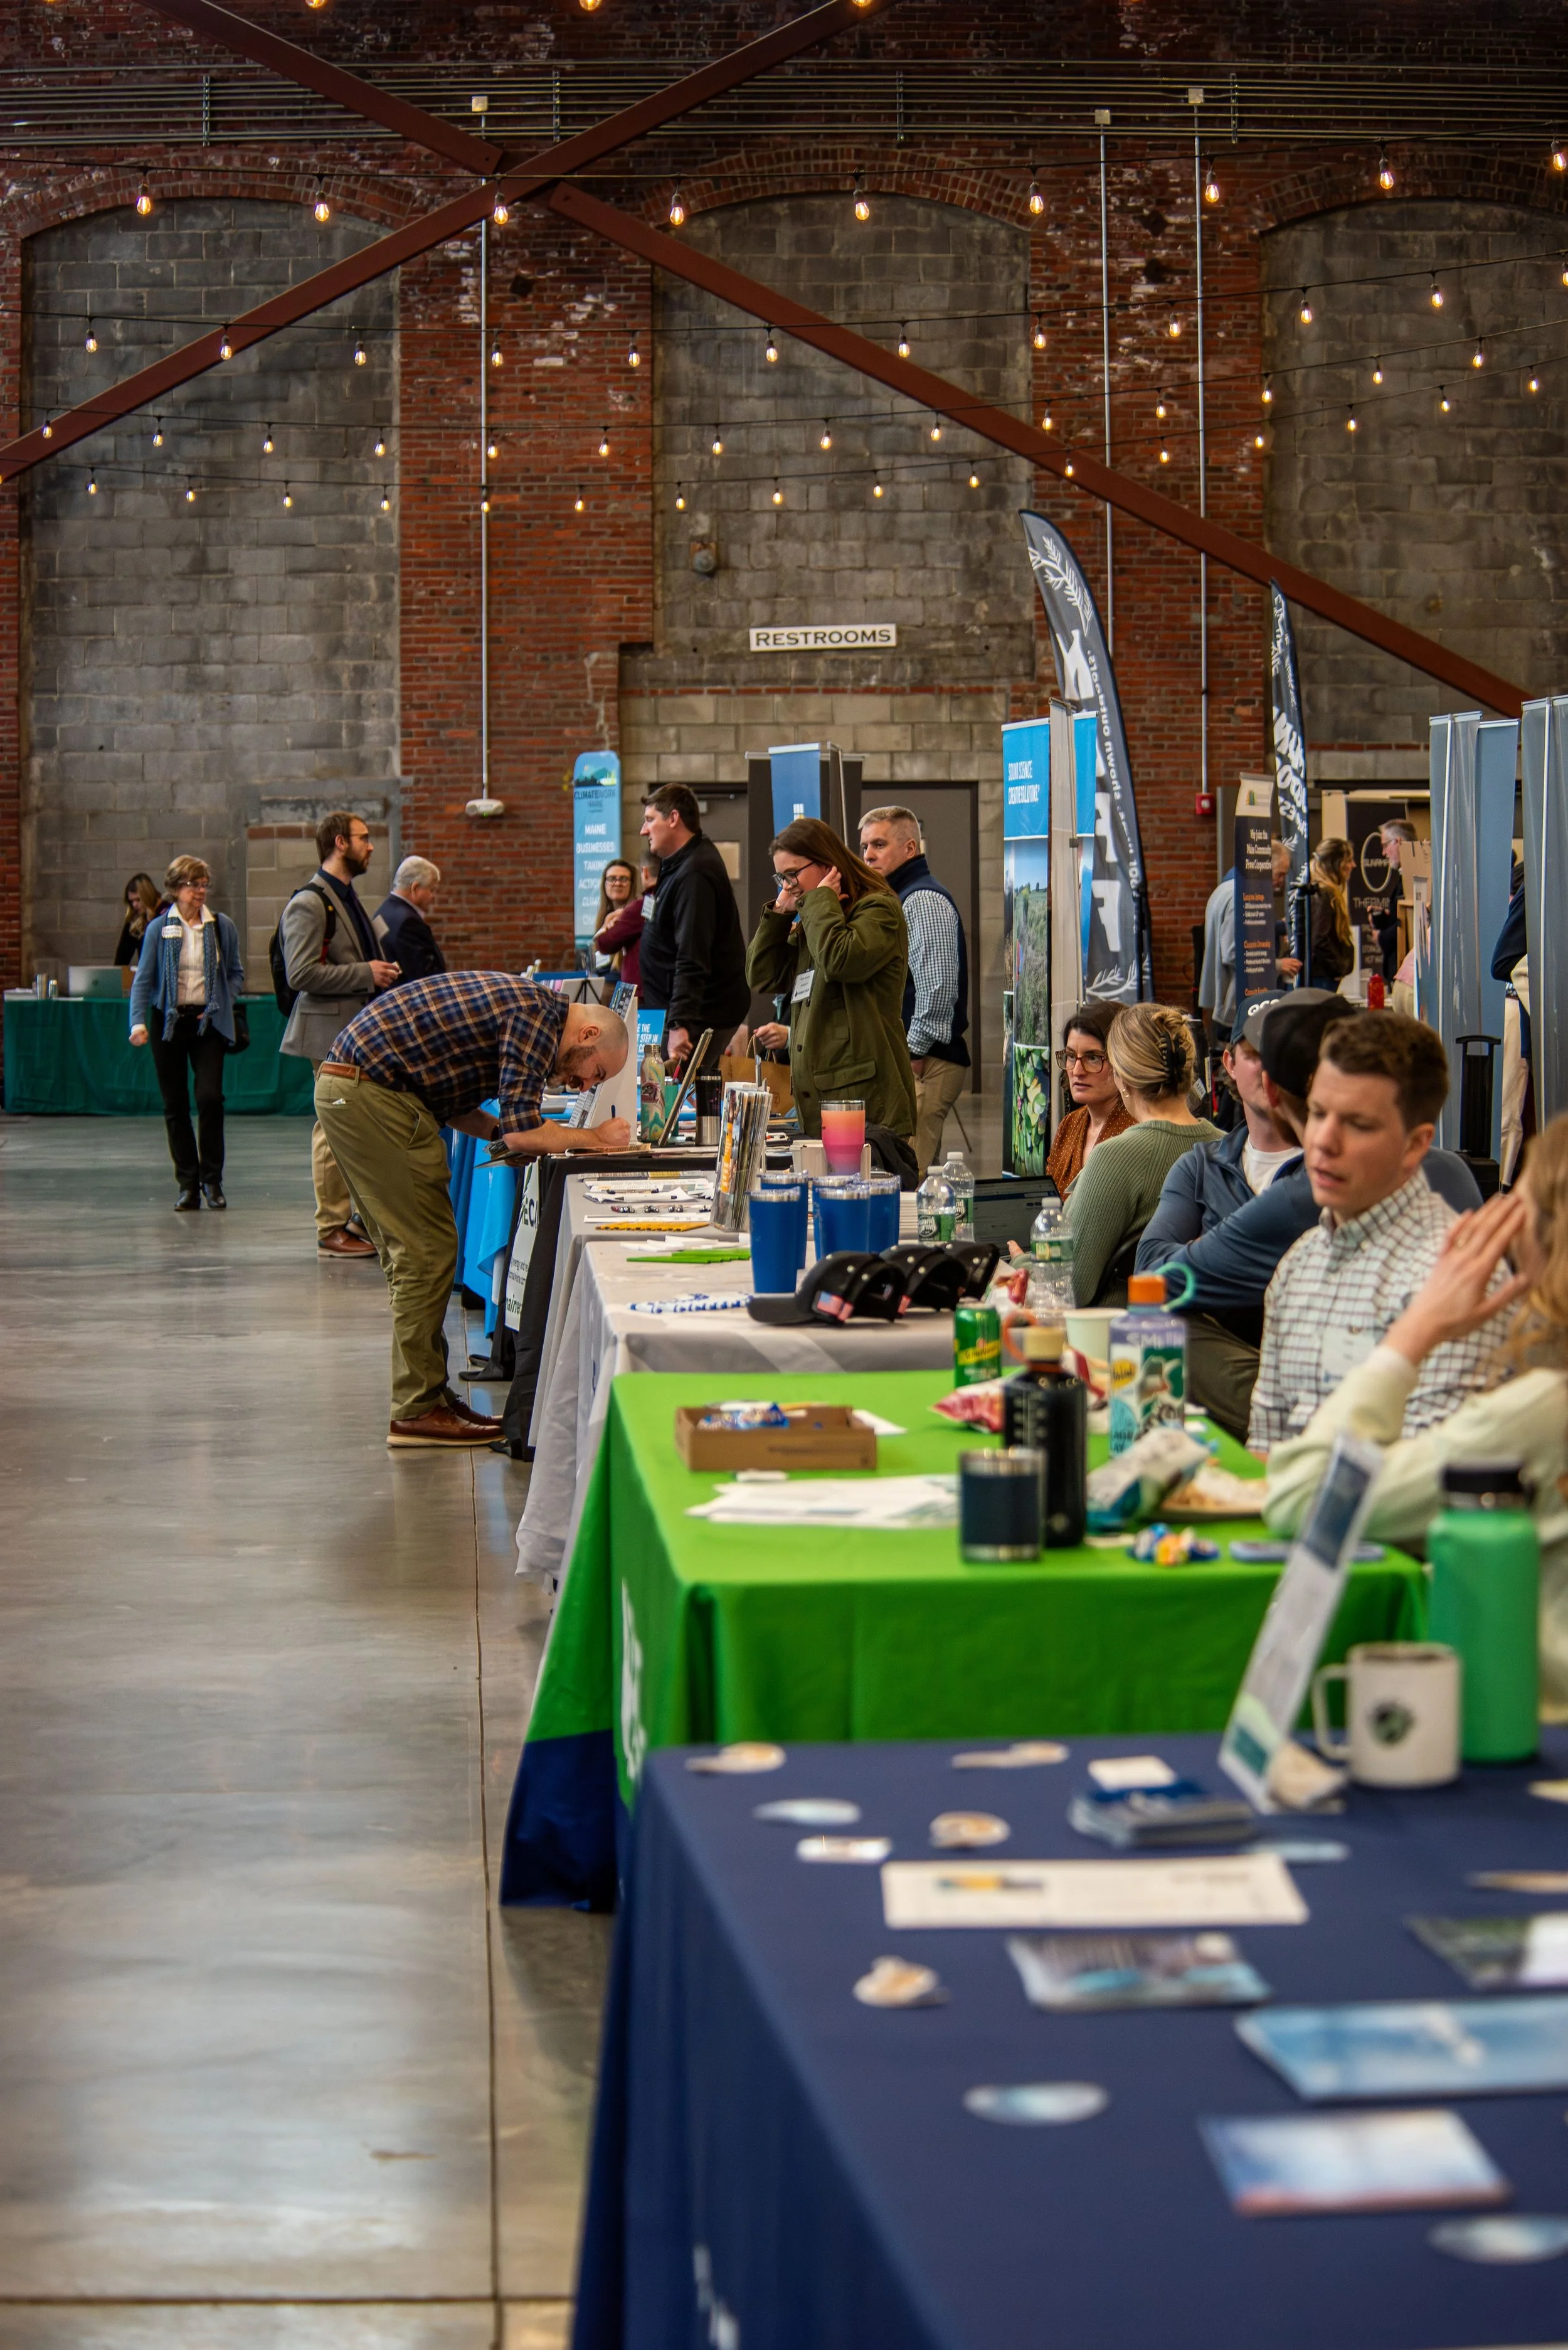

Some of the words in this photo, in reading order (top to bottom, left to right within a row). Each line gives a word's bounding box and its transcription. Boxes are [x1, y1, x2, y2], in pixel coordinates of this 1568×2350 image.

[755, 629, 891, 646] RESTROOMS
[584, 823, 607, 836] MAINE
[576, 841, 615, 854] BUSINESSES
[641, 1023, 650, 1033] THE
[640, 1034, 652, 1043] STEP
[652, 1034, 658, 1043] IN
